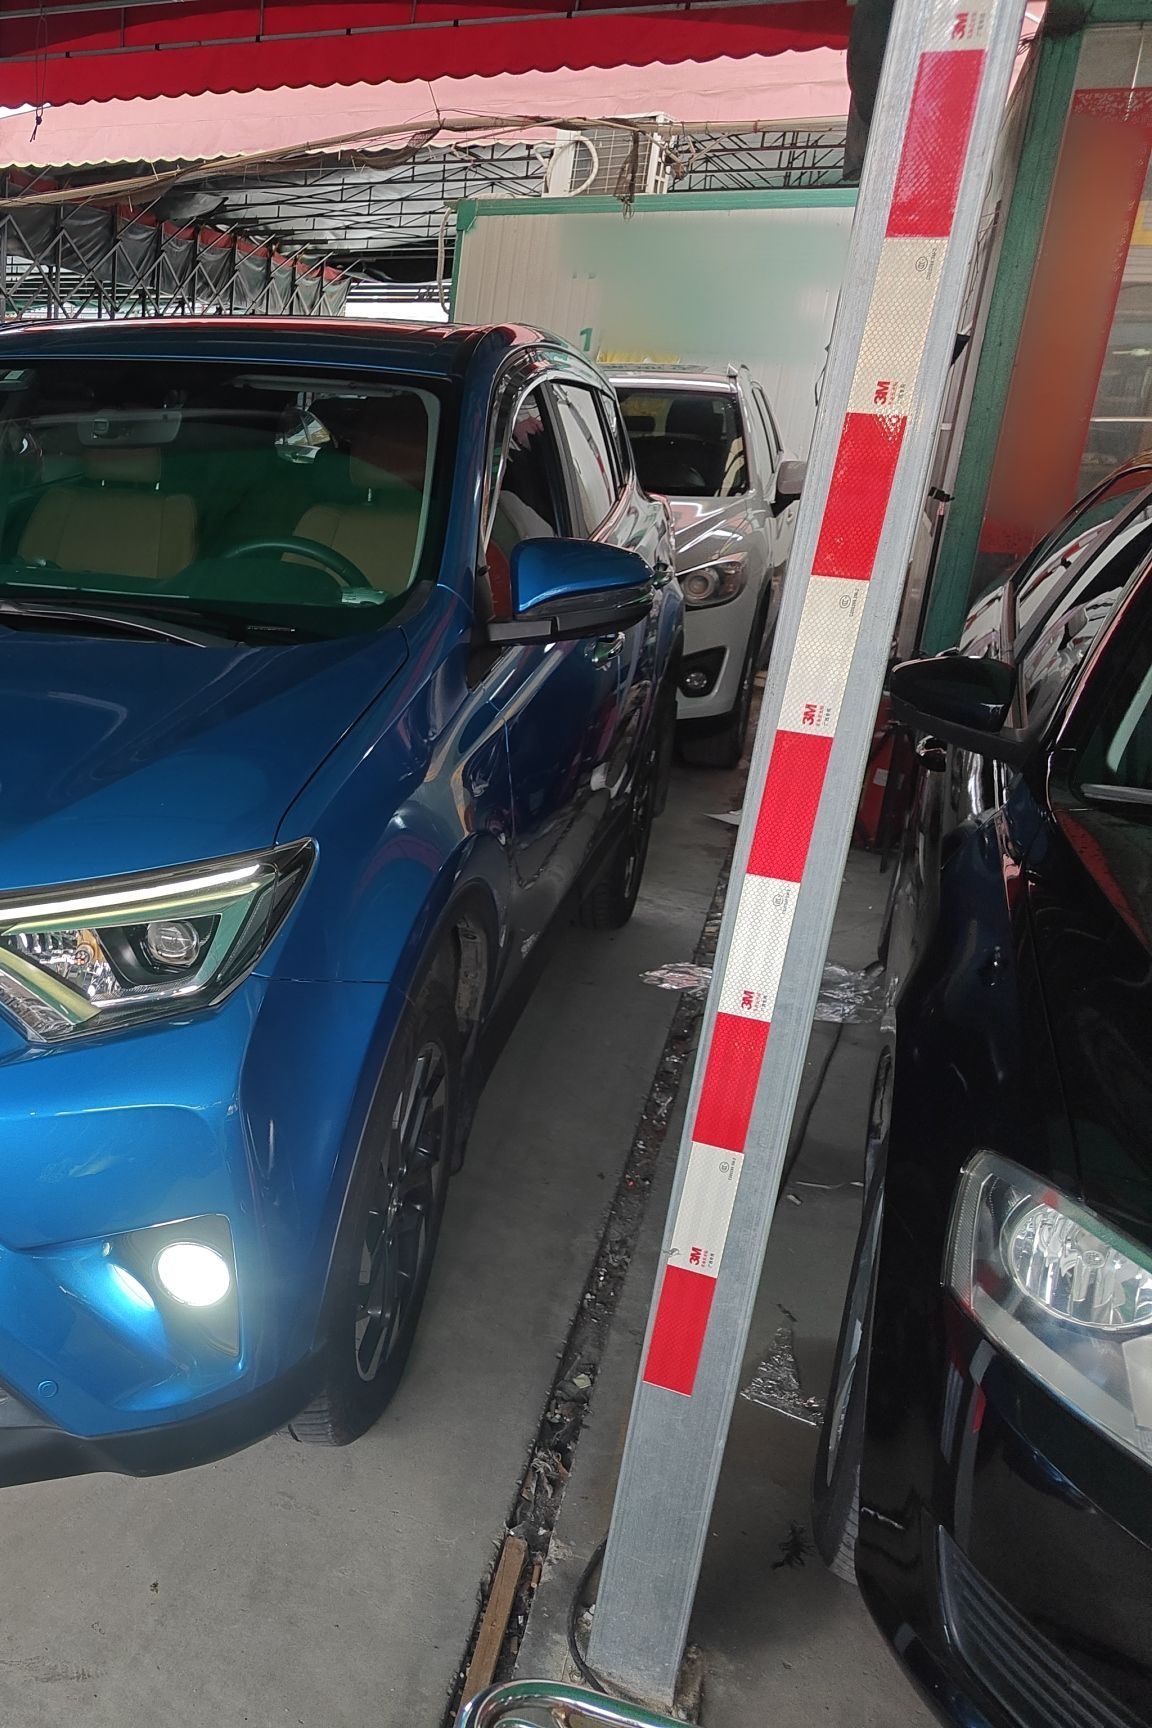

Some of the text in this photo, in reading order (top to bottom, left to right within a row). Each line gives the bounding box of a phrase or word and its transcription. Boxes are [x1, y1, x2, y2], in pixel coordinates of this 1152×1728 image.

[951, 12, 968, 40] 3M
[873, 380, 891, 406] 3M
[802, 703, 817, 726] 3M
[741, 990, 755, 1011] 3M
[689, 1246, 703, 1266] 3M
